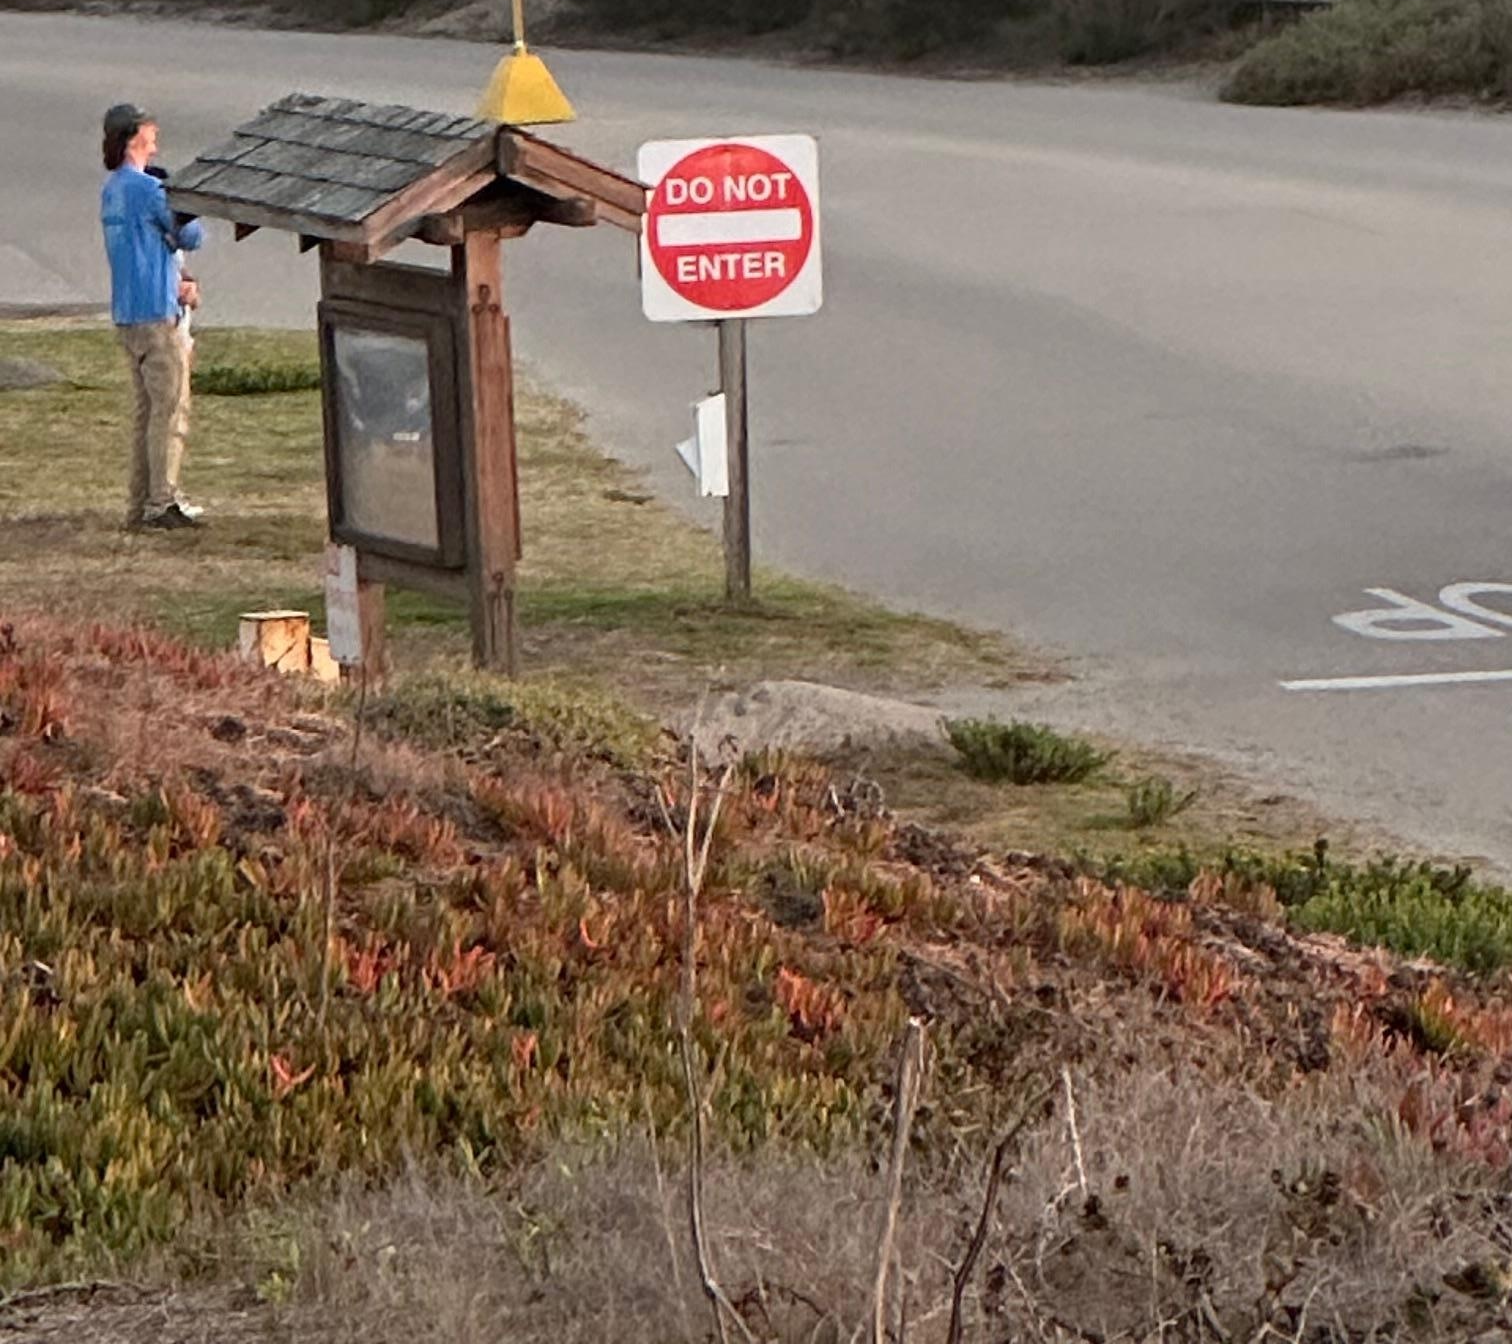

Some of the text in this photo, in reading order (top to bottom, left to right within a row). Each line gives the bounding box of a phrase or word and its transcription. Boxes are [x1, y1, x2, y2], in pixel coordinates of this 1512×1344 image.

[666, 172, 791, 205] DO NOT
[677, 251, 786, 282] ENTER
